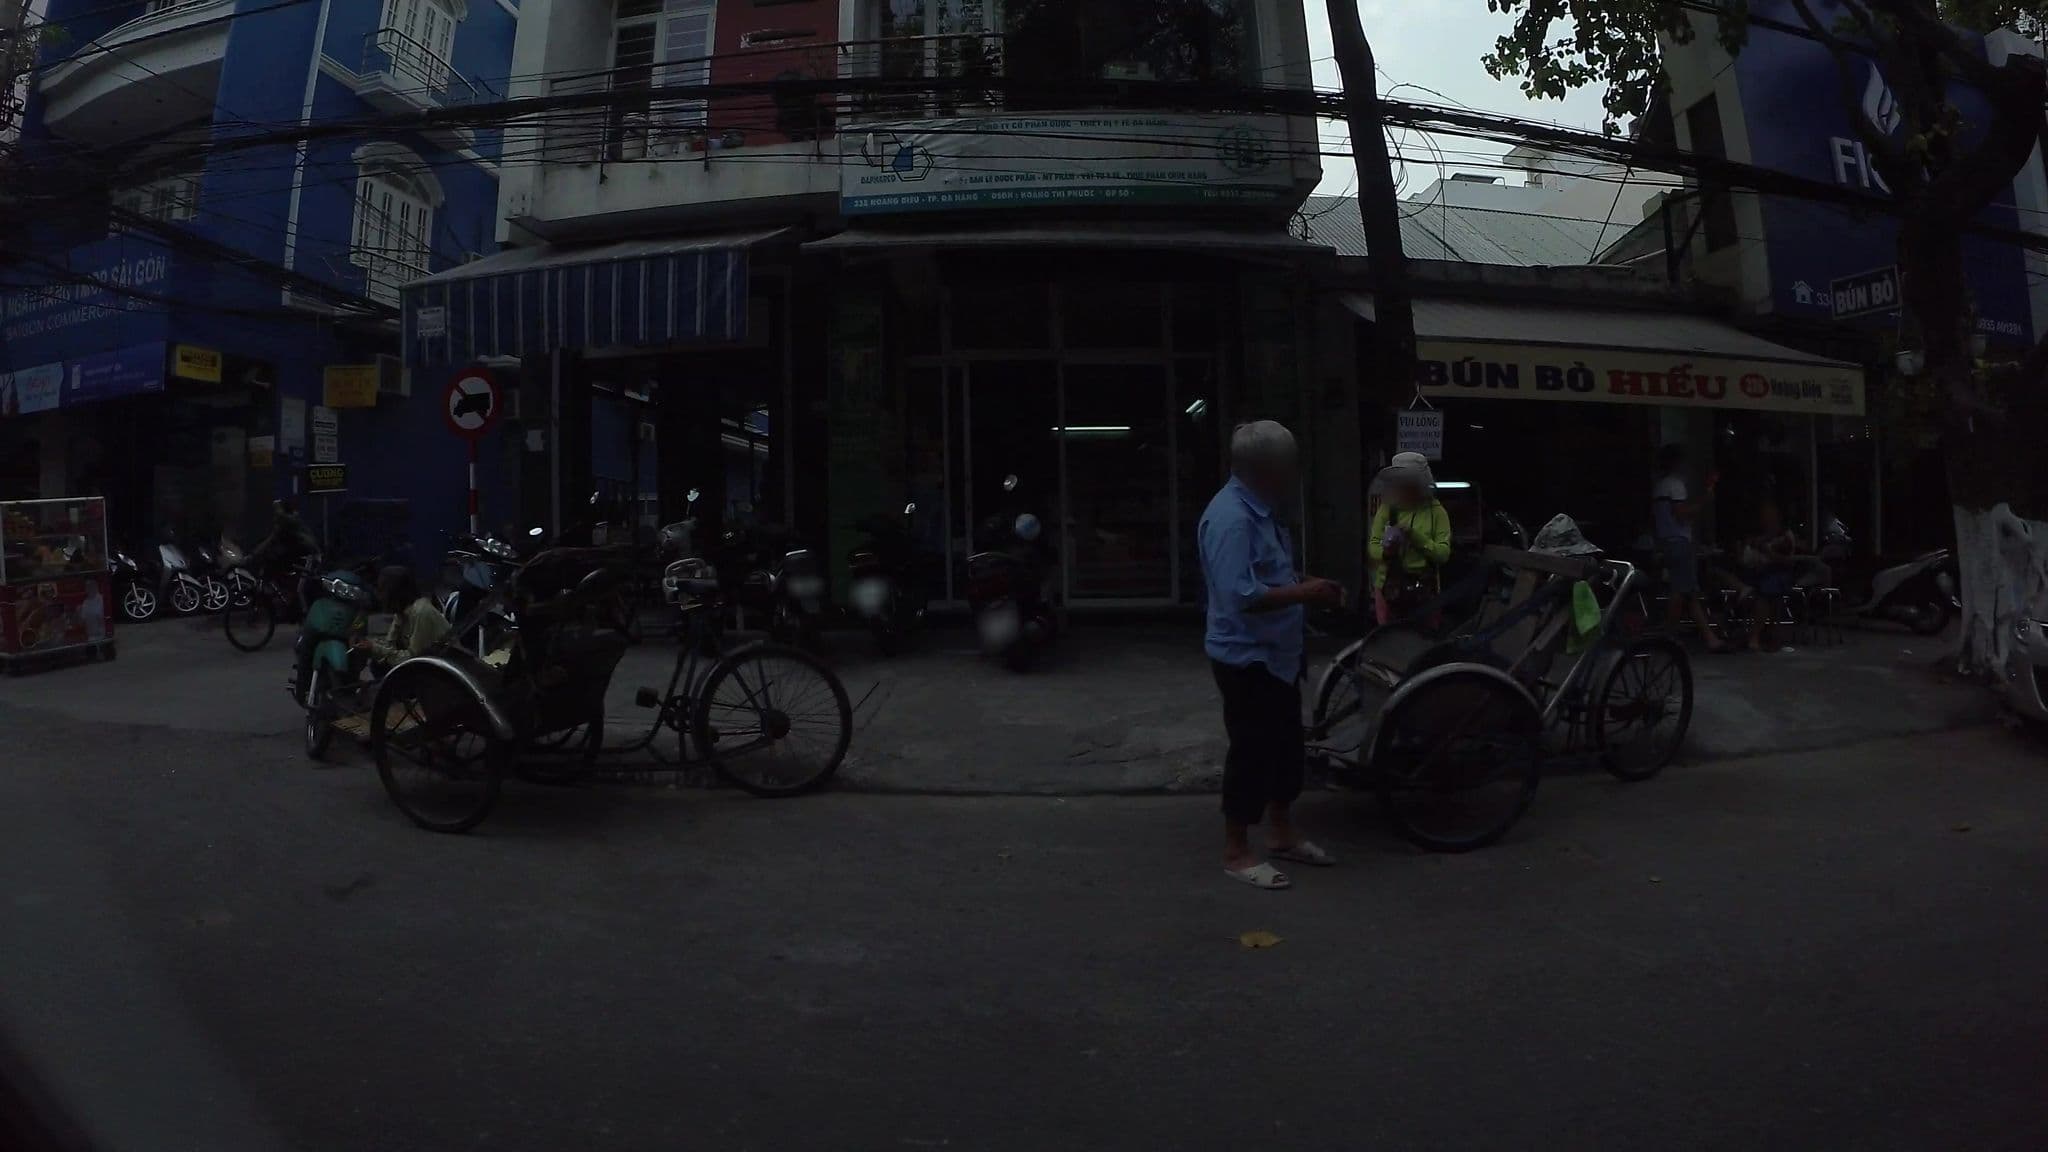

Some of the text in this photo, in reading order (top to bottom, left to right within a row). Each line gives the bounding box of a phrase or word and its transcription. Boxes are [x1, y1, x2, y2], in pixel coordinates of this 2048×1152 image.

[1835, 273, 1895, 314] BÚN BÒ
[1418, 356, 1520, 389] BÚN
[1535, 361, 1596, 393] BÒ
